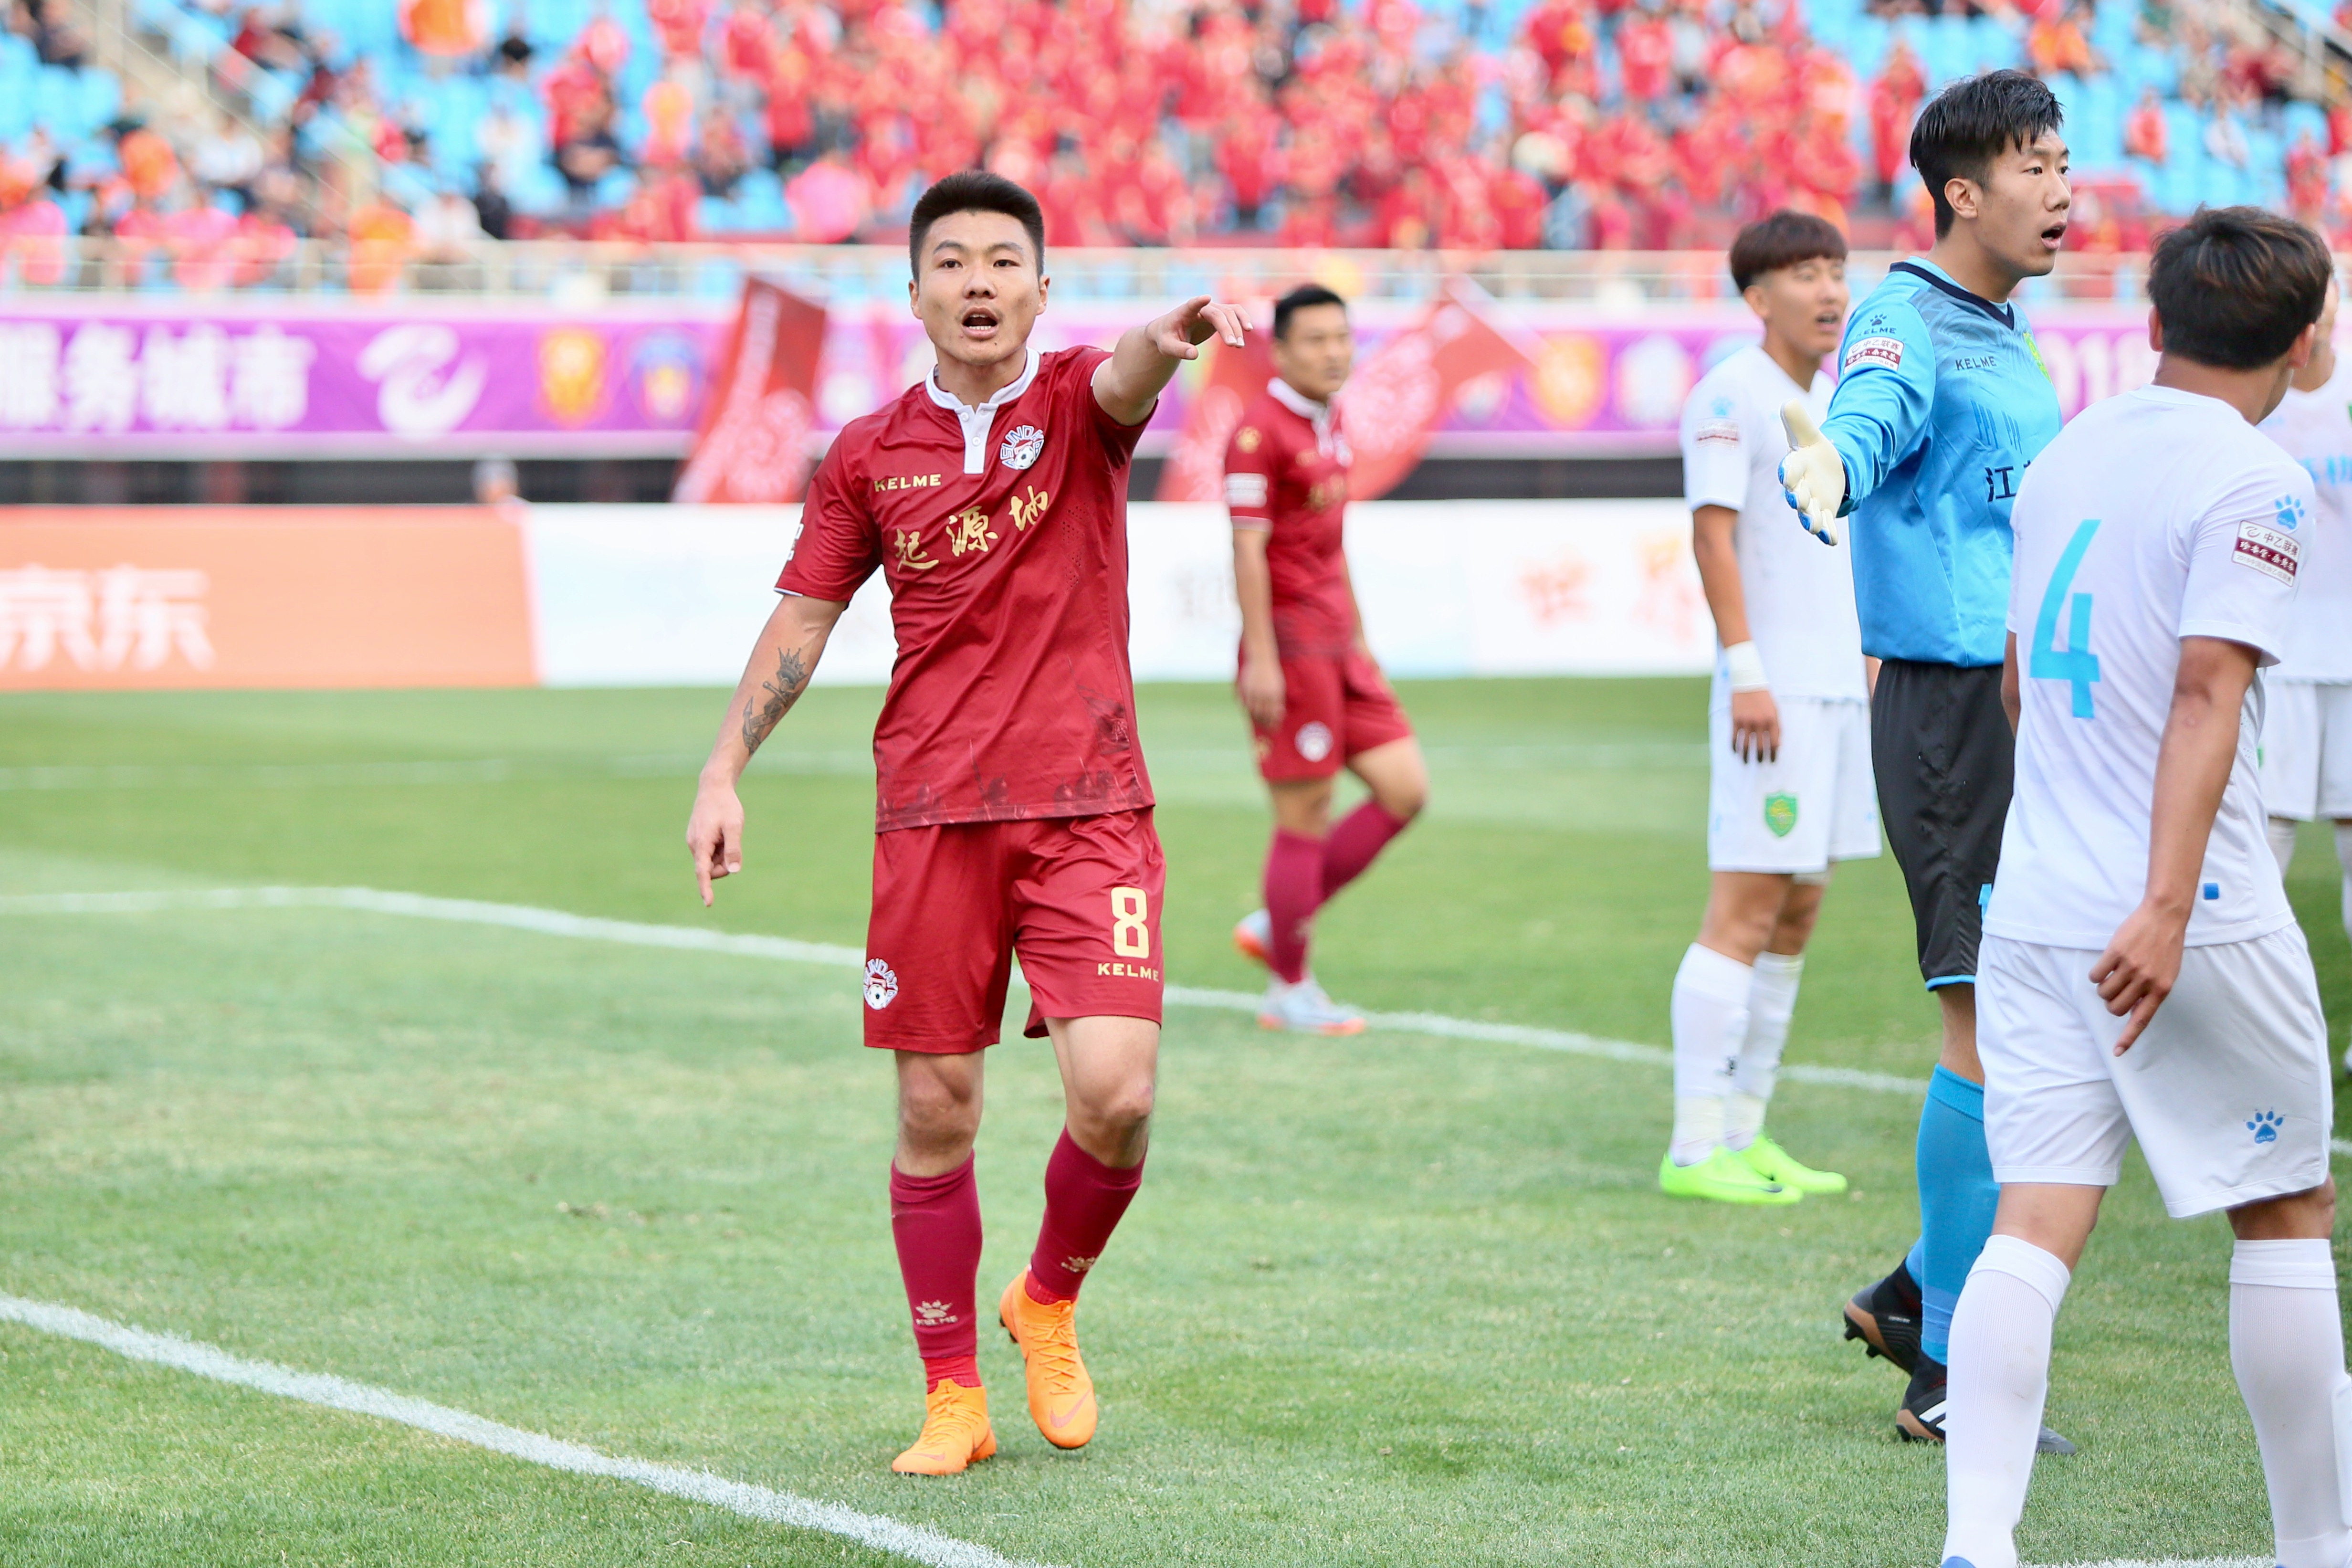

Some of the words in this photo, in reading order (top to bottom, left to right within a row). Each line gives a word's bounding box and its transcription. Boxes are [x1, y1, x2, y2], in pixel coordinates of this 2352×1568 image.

[1863, 339, 1900, 351] 中乙联赛
[1955, 356, 1997, 370] KELME
[874, 474, 941, 492] KELME
[2263, 533, 2299, 557] 中乙联赛
[2029, 519, 2102, 719] 4
[1111, 886, 1149, 959] 8
[1098, 962, 1159, 982] KELME
